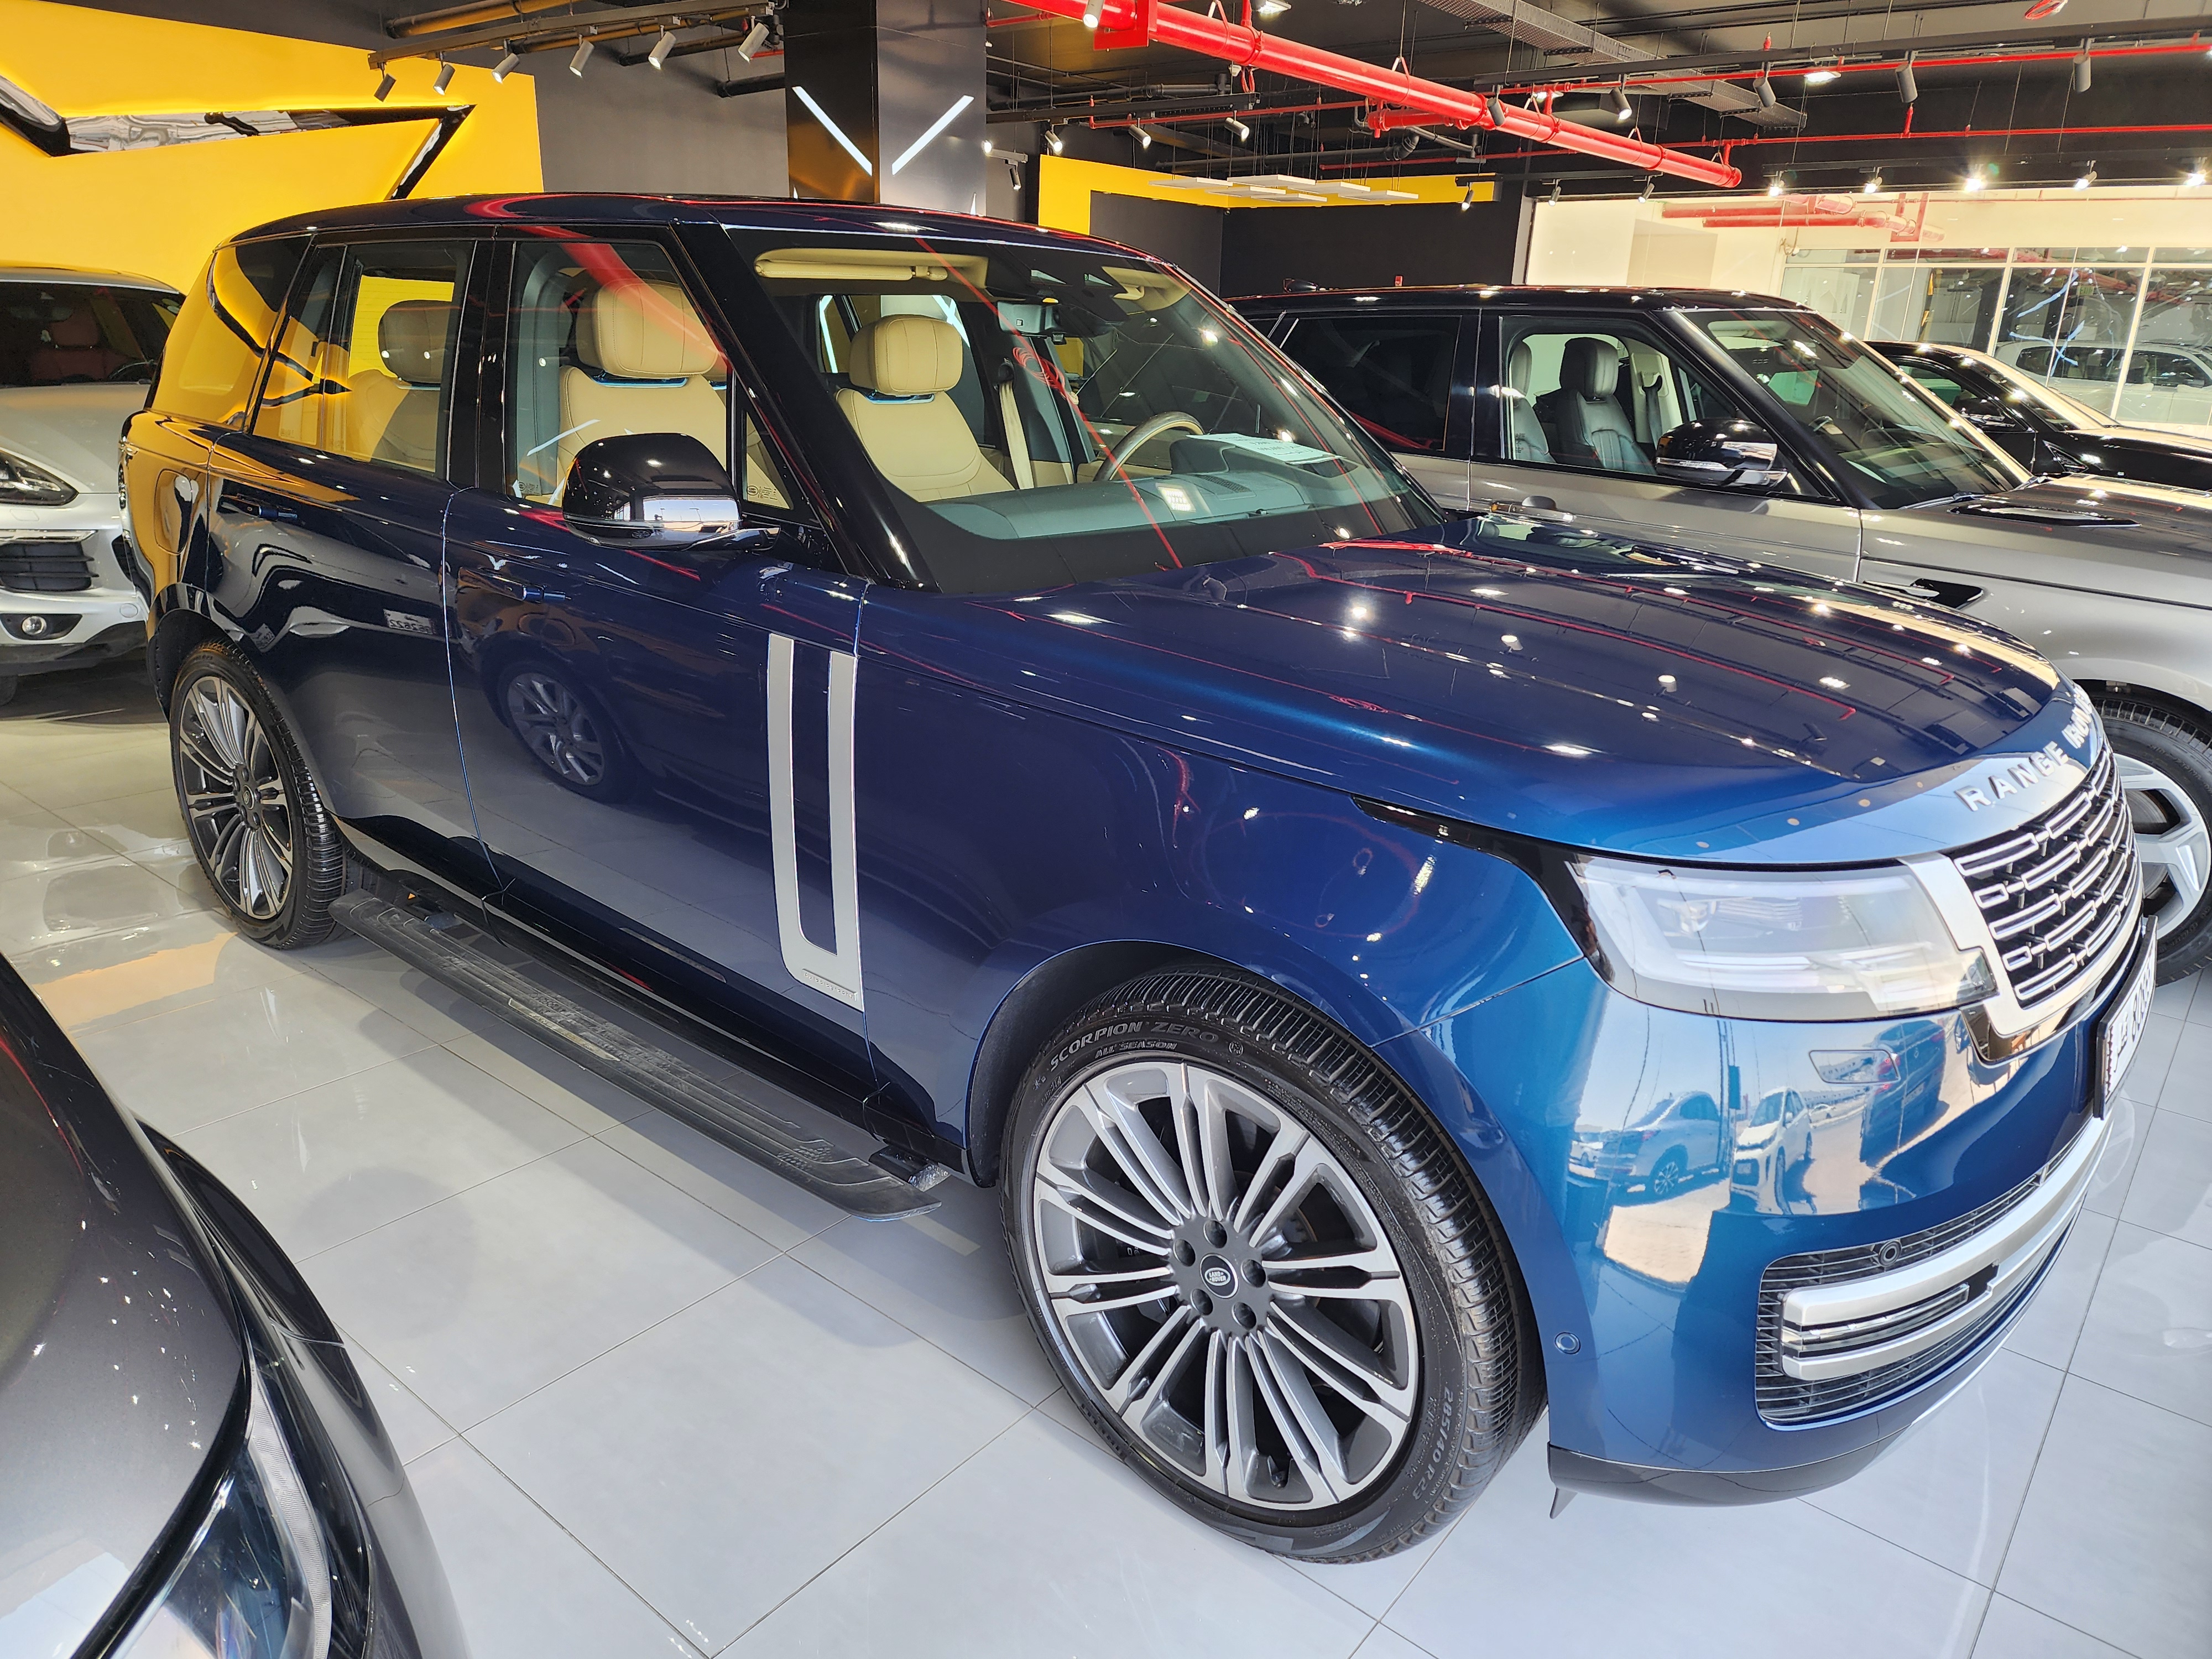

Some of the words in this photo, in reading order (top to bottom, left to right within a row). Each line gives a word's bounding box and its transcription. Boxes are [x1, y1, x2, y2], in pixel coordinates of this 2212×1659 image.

[1953, 740, 2069, 812] RANGE
[1050, 1021, 1143, 1072] SCORPION
[1151, 1021, 1219, 1043] ZERO
[1094, 1045, 1115, 1058] ALL
[1119, 1039, 1177, 1050] SEASON
[1432, 1386, 1454, 1463] 285/40
